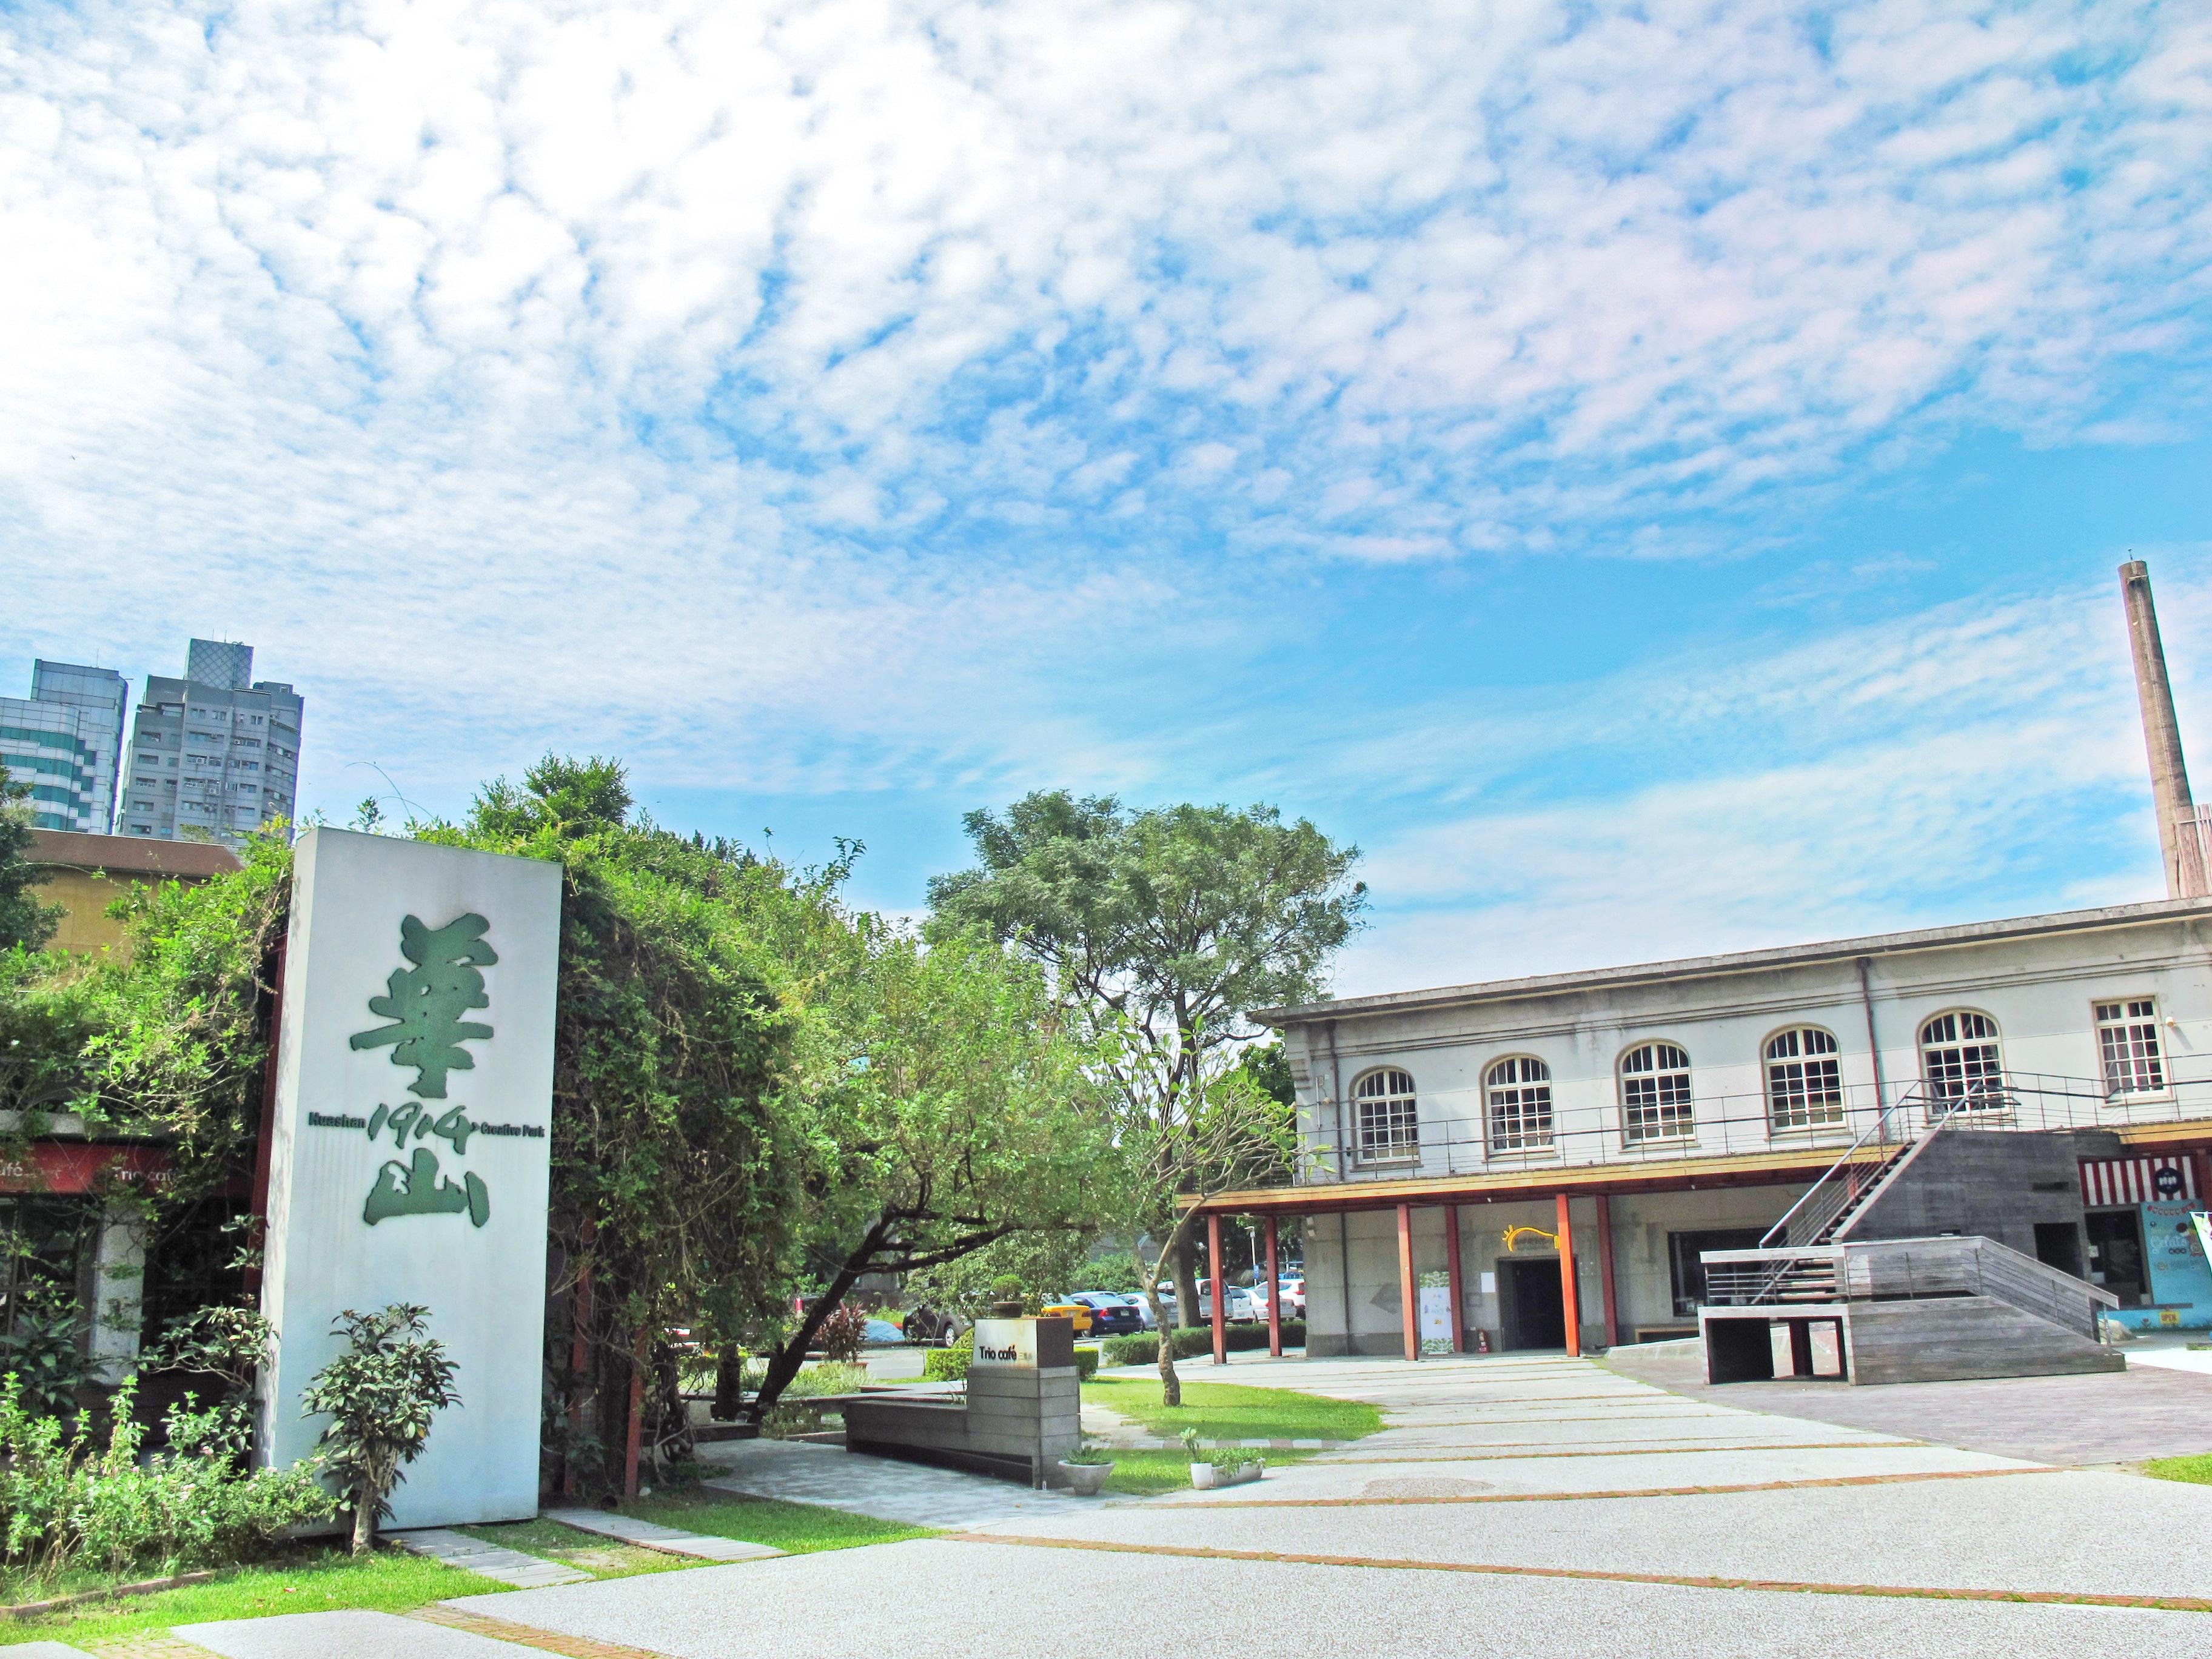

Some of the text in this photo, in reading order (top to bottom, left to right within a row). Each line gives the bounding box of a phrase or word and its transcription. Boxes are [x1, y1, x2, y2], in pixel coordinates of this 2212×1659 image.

[350, 912, 498, 1098] 華
[309, 1102, 545, 1155] Huashan 1914 Creative Park
[364, 1148, 490, 1227] 山
[979, 1346, 996, 1359] Trio
[998, 1344, 1017, 1360] café
